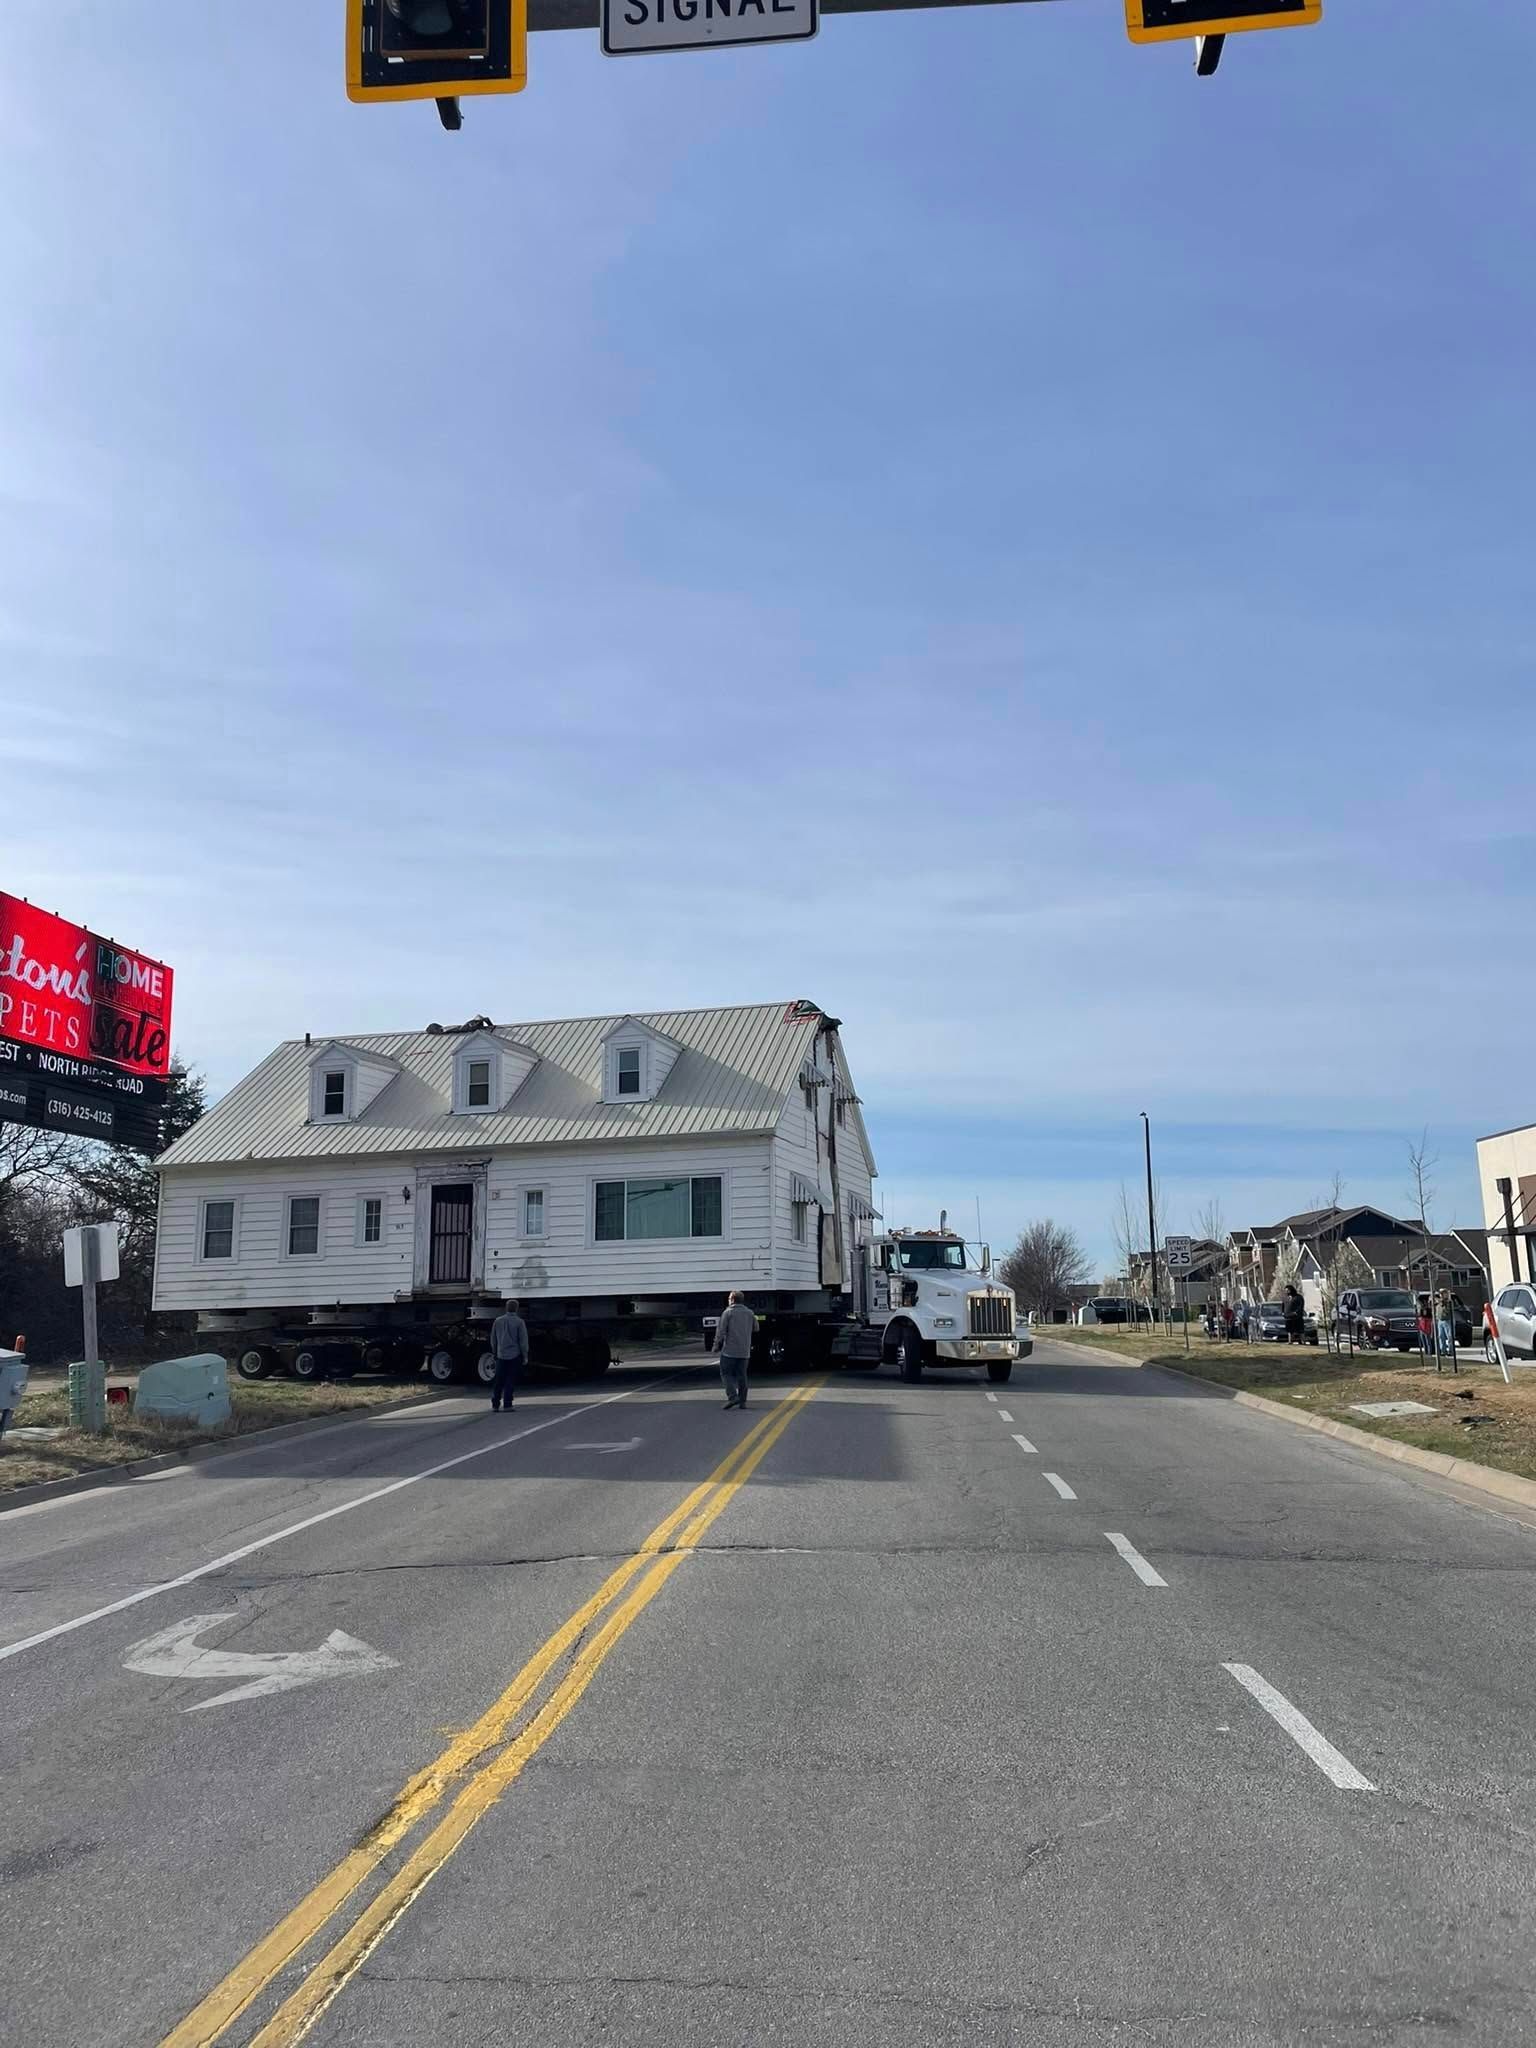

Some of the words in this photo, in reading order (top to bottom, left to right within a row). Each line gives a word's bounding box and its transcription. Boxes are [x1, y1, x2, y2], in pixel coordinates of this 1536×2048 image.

[0, 934, 92, 1006] ton's
[97, 945, 164, 999] HOME
[39, 1052, 79, 1076] NORTH
[48, 1100, 72, 1118] (316)
[73, 1105, 112, 1125] 425-4125
[1169, 1252, 1190, 1264] 25
